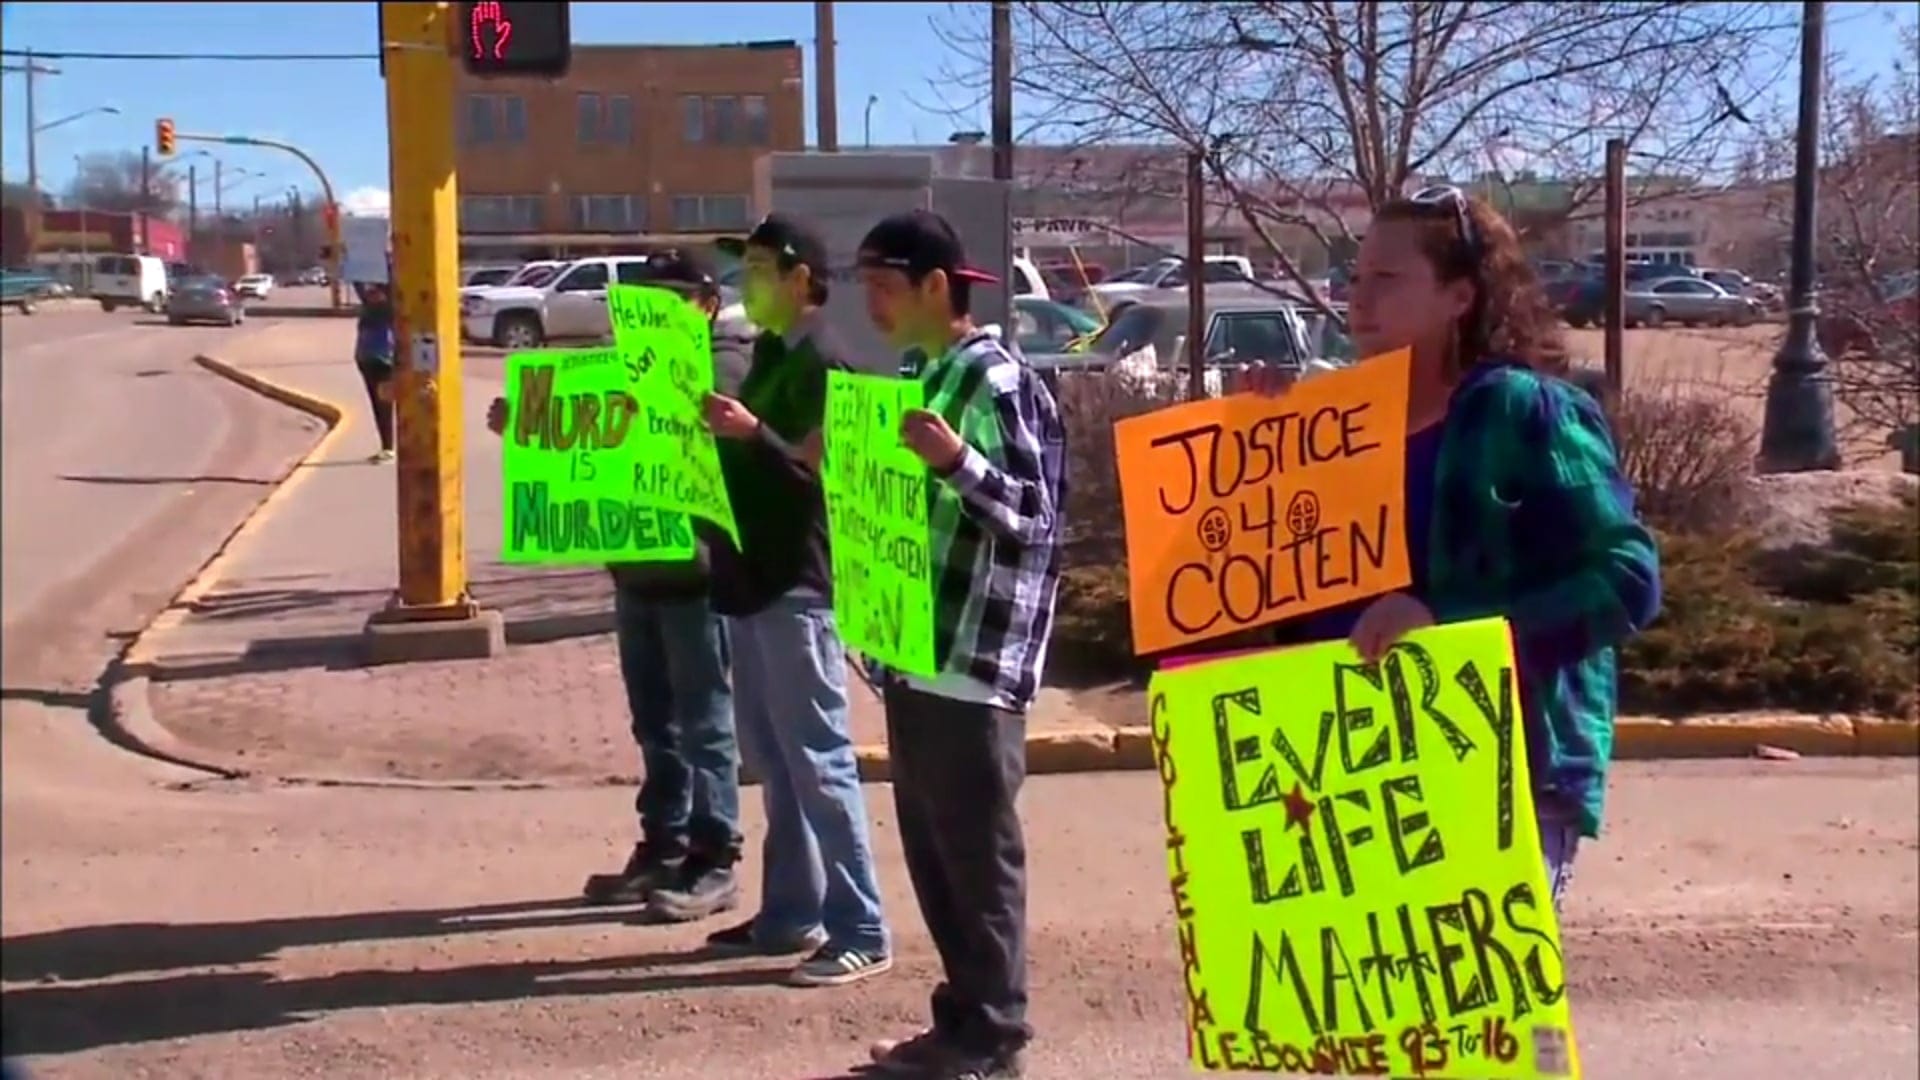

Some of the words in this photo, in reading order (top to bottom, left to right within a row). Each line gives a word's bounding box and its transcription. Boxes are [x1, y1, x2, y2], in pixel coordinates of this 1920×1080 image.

[624, 346, 656, 383] Son
[571, 452, 596, 481] IS
[1151, 402, 1382, 515] JUSTICE
[512, 482, 690, 553] MURDER
[1240, 485, 1277, 550] 4
[1166, 503, 1388, 635] COLTEN
[1211, 641, 1514, 851] EVERY
